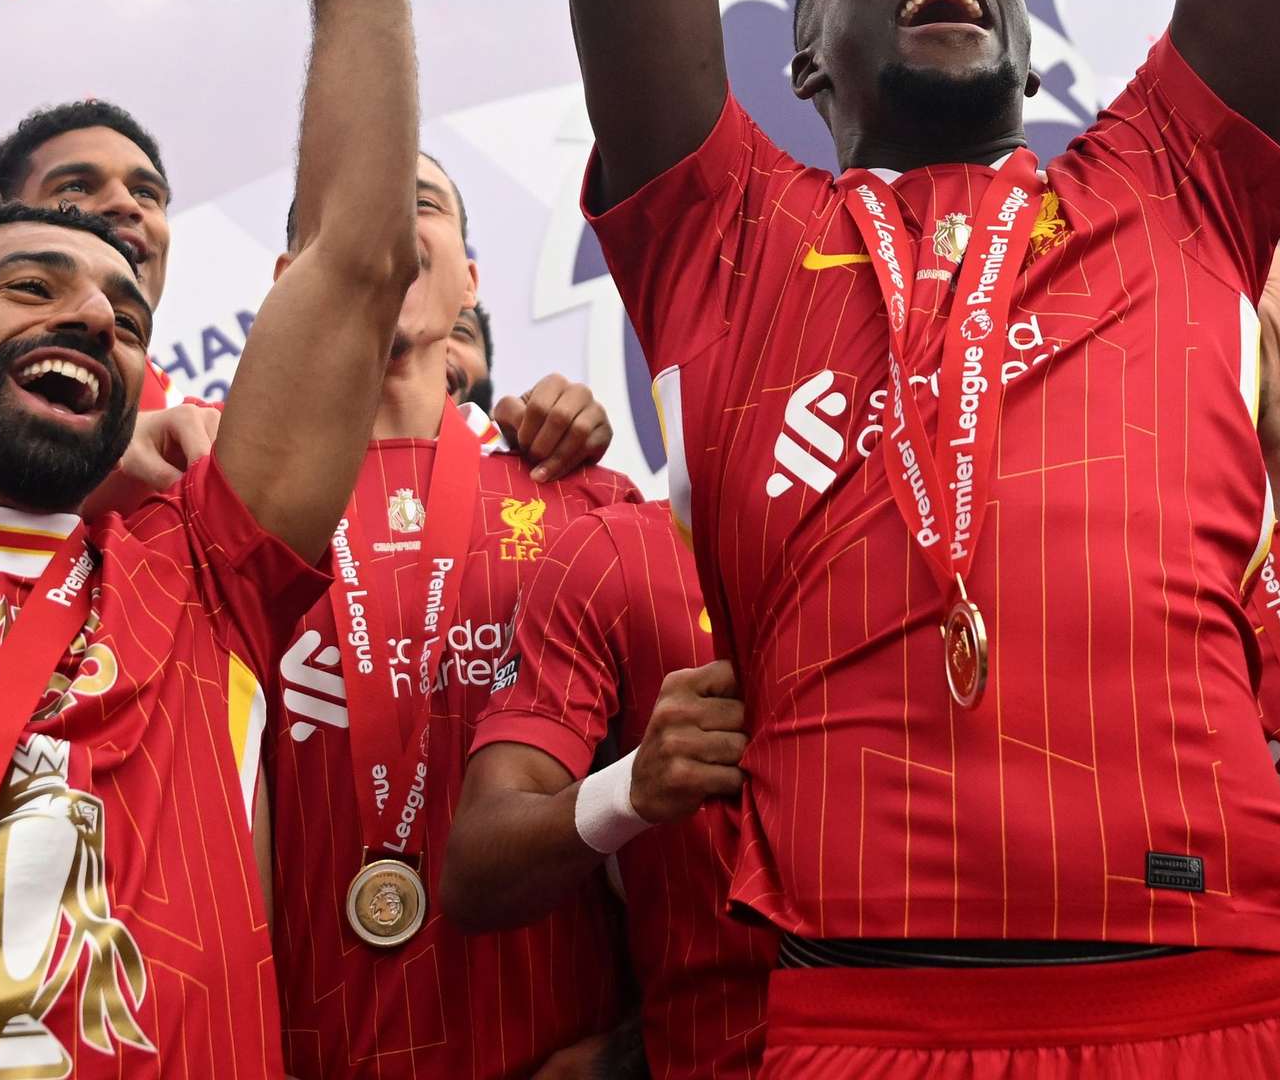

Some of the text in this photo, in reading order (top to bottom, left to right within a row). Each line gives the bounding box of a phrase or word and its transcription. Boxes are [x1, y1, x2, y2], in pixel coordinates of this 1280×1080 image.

[966, 185, 1029, 306] Premier League
[897, 439, 941, 548] Premier
[949, 345, 988, 560] Premier League
[346, 590, 374, 674] League
[424, 557, 455, 633] Premier
[382, 762, 427, 853] League
